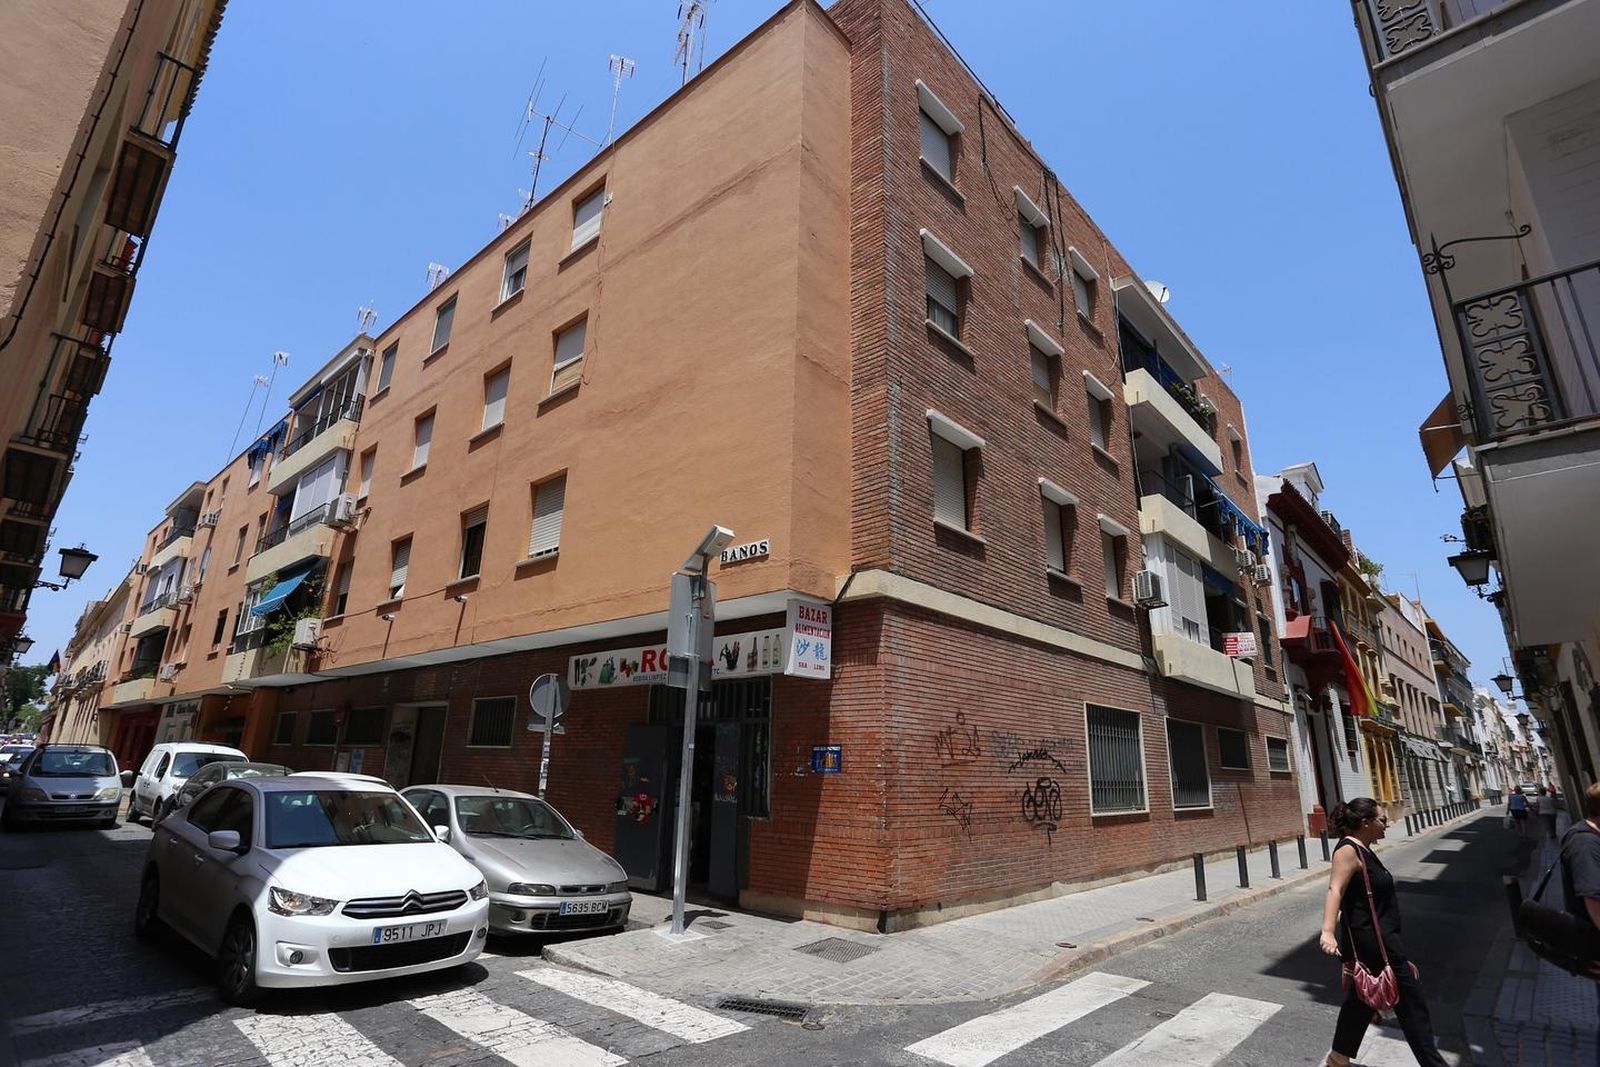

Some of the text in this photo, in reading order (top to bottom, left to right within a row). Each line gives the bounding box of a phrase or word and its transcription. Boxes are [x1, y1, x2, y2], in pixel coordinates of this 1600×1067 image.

[798, 605, 828, 625] BAZAR
[566, 903, 589, 914] 5635
[383, 922, 442, 942] 9511 JPJ
